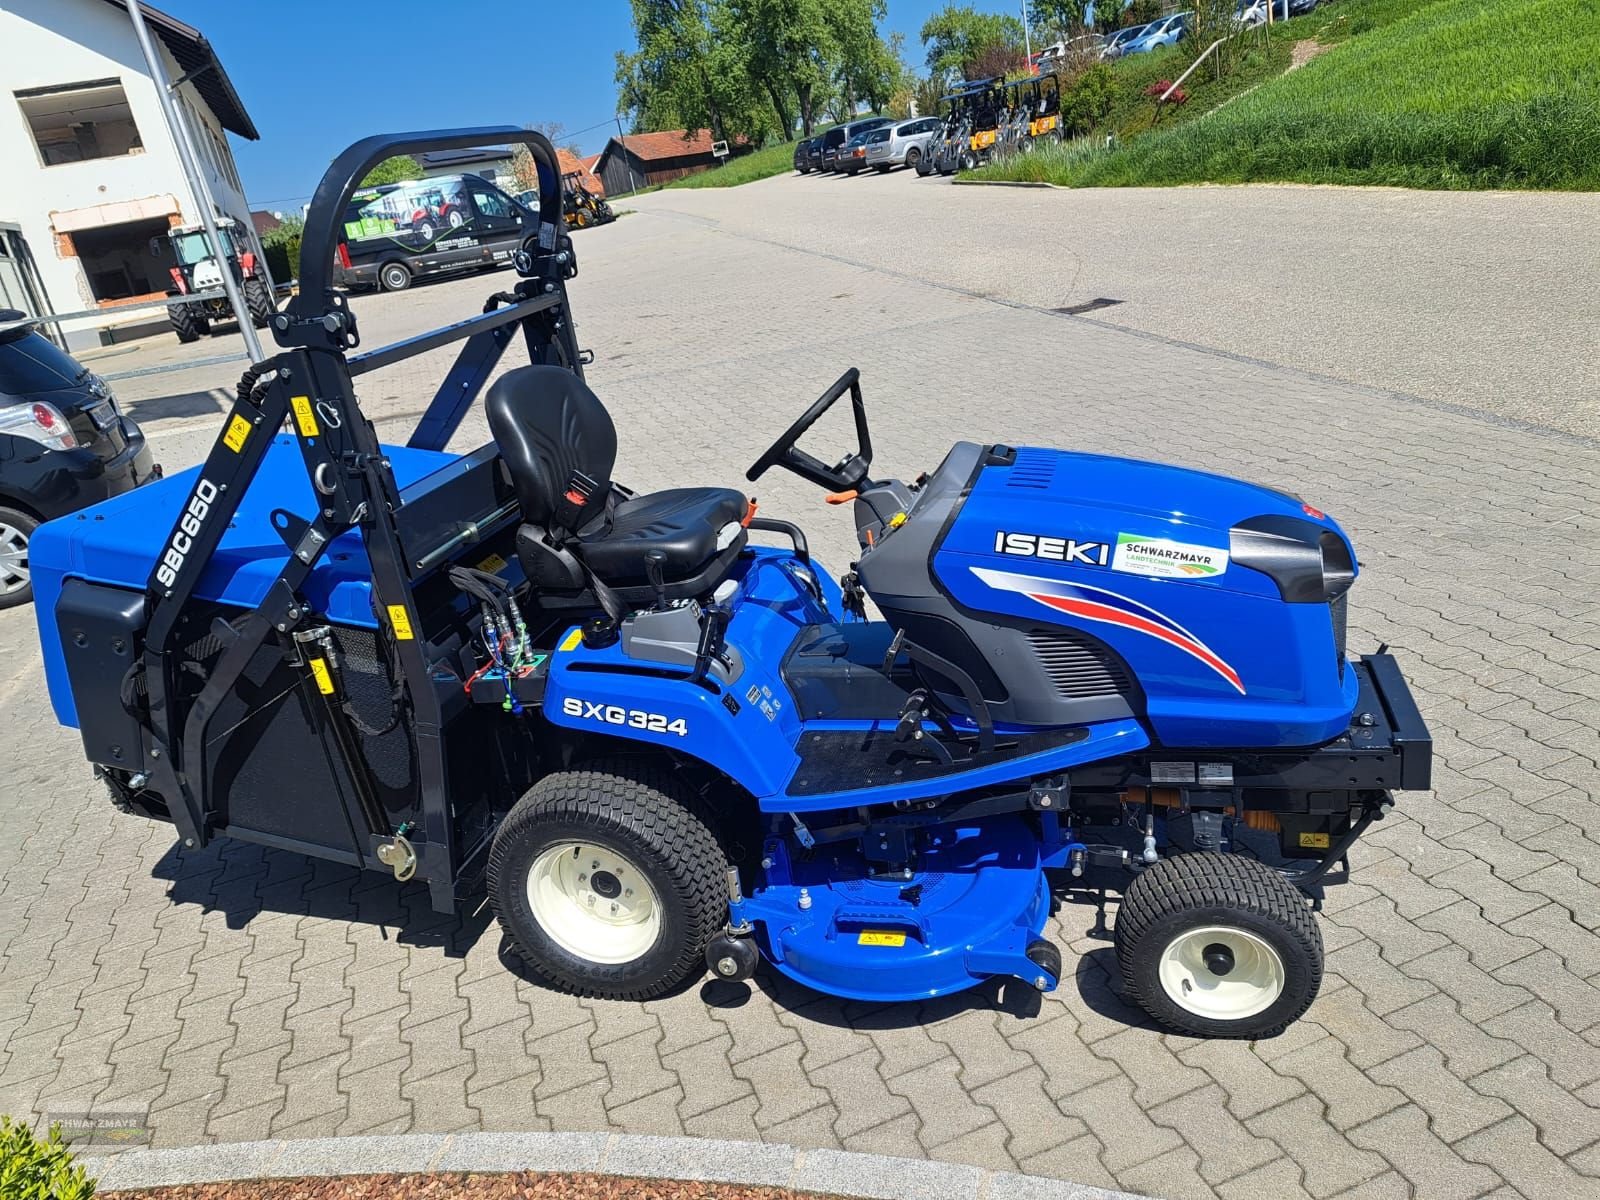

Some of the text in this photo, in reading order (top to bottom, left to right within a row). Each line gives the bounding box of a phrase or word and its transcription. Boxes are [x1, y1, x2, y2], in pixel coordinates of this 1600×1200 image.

[156, 479, 218, 588] SBC650
[994, 531, 1109, 566] ISEKI
[1126, 543, 1212, 565] SCHWARZMAYR
[1126, 554, 1175, 567] LANDTECHNIK
